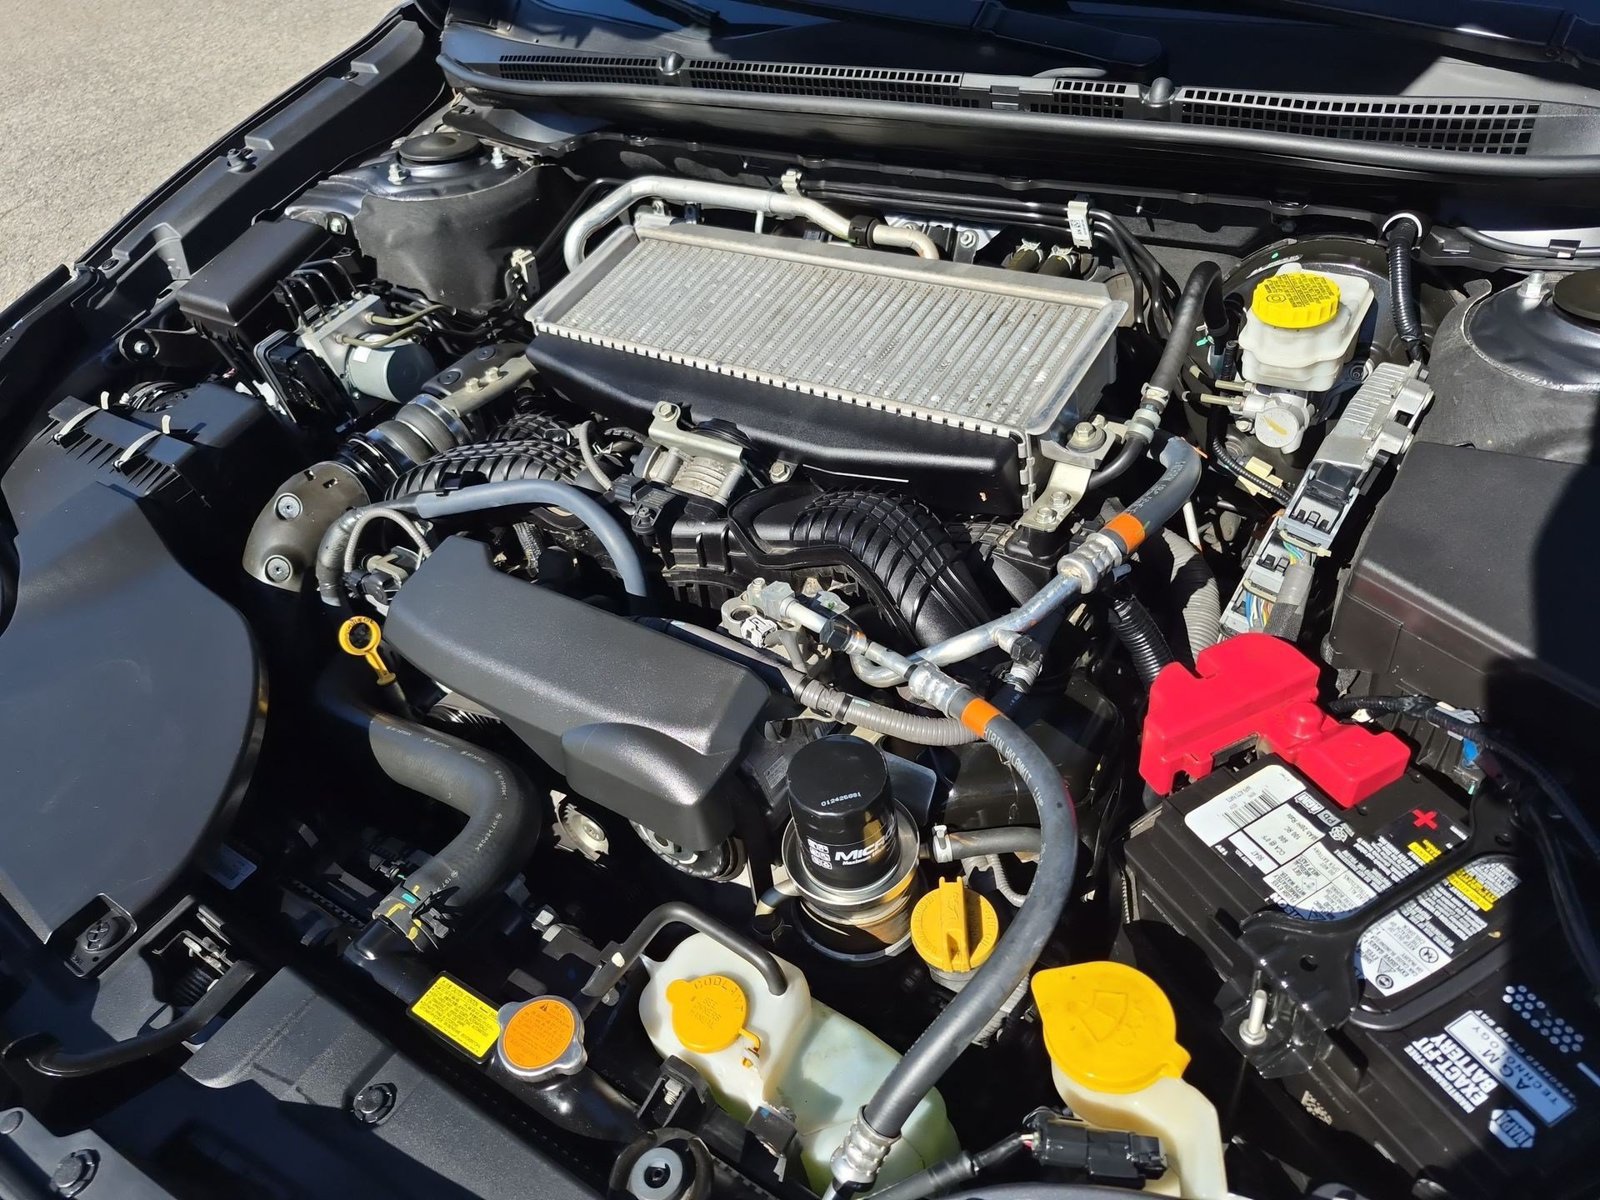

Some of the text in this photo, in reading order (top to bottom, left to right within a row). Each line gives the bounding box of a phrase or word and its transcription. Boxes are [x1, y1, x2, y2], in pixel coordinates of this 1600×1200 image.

[1297, 792, 1321, 813] AGM
[1320, 812, 1336, 825] Pb
[1384, 954, 1409, 977] EXPLOSIVE
[1474, 1008, 1496, 1026] MAT
[1411, 1036, 1489, 1104] EXACT-FIT
[1429, 1031, 1498, 1091] BATTERY
[1471, 1025, 1560, 1104] TECHNOLOGY
[1493, 1112, 1532, 1146] NAPA
